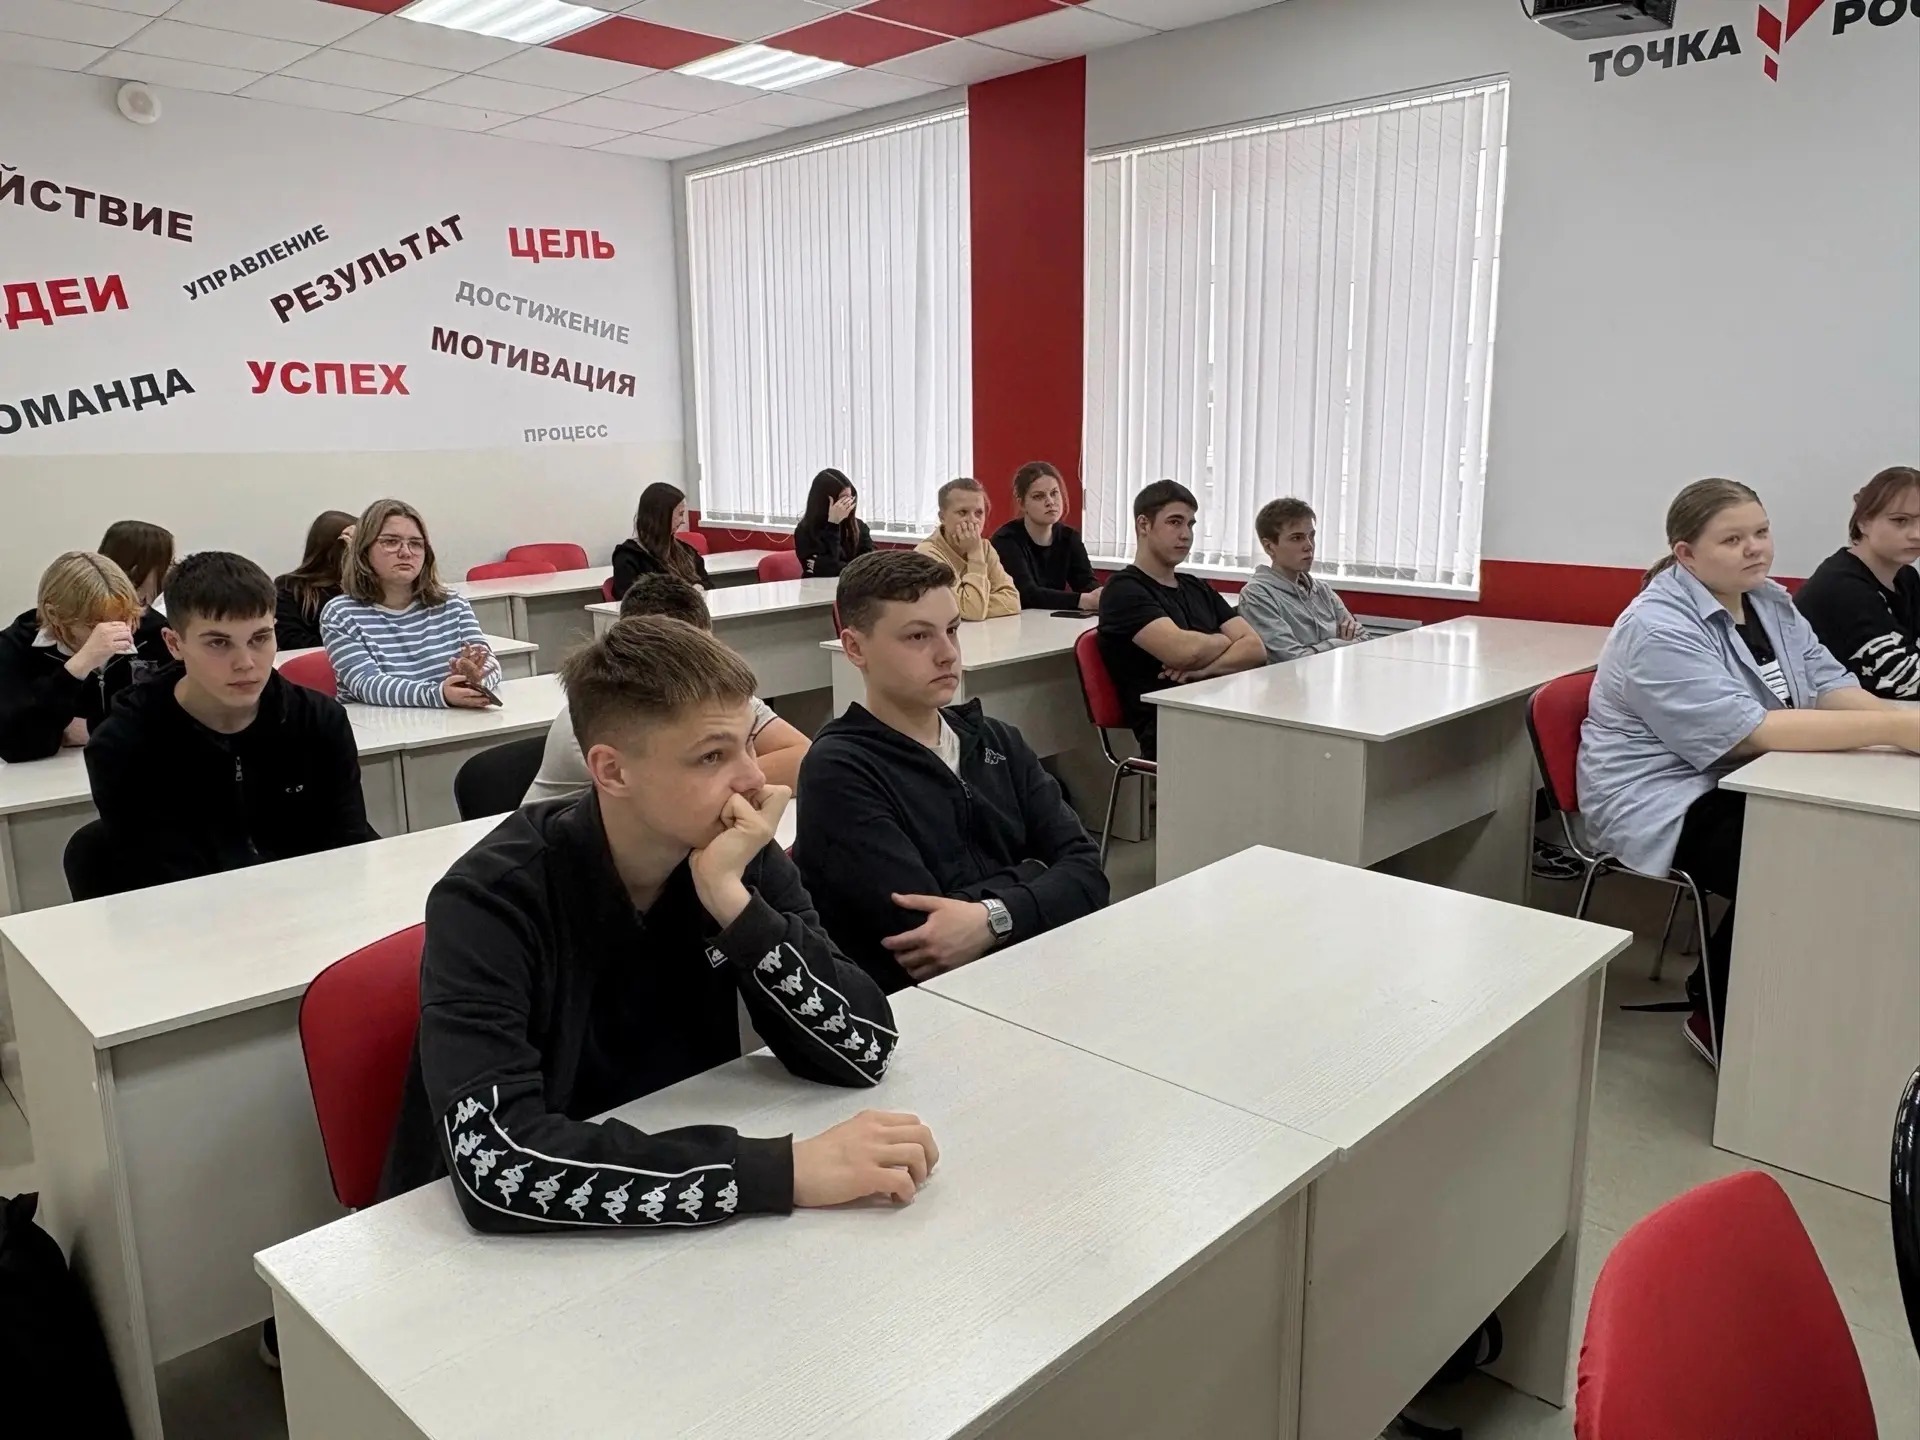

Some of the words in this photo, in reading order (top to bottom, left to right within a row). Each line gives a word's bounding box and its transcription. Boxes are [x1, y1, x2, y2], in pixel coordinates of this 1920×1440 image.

[1588, 25, 1741, 82] ТОЧКА
[183, 224, 329, 300] УПРАВЛЕНИЕ
[270, 214, 464, 323] РЕЗУЛЬТАТ
[508, 227, 616, 263] ЦЕЛЬ
[0, 274, 129, 330] ДЕИ
[455, 281, 630, 344] ДОСТИЖЕНИЕ
[247, 360, 410, 395] УСПЕХ
[431, 326, 636, 397] МОТИВАЦИЯ
[524, 424, 608, 442] ПРОЦЕСС
